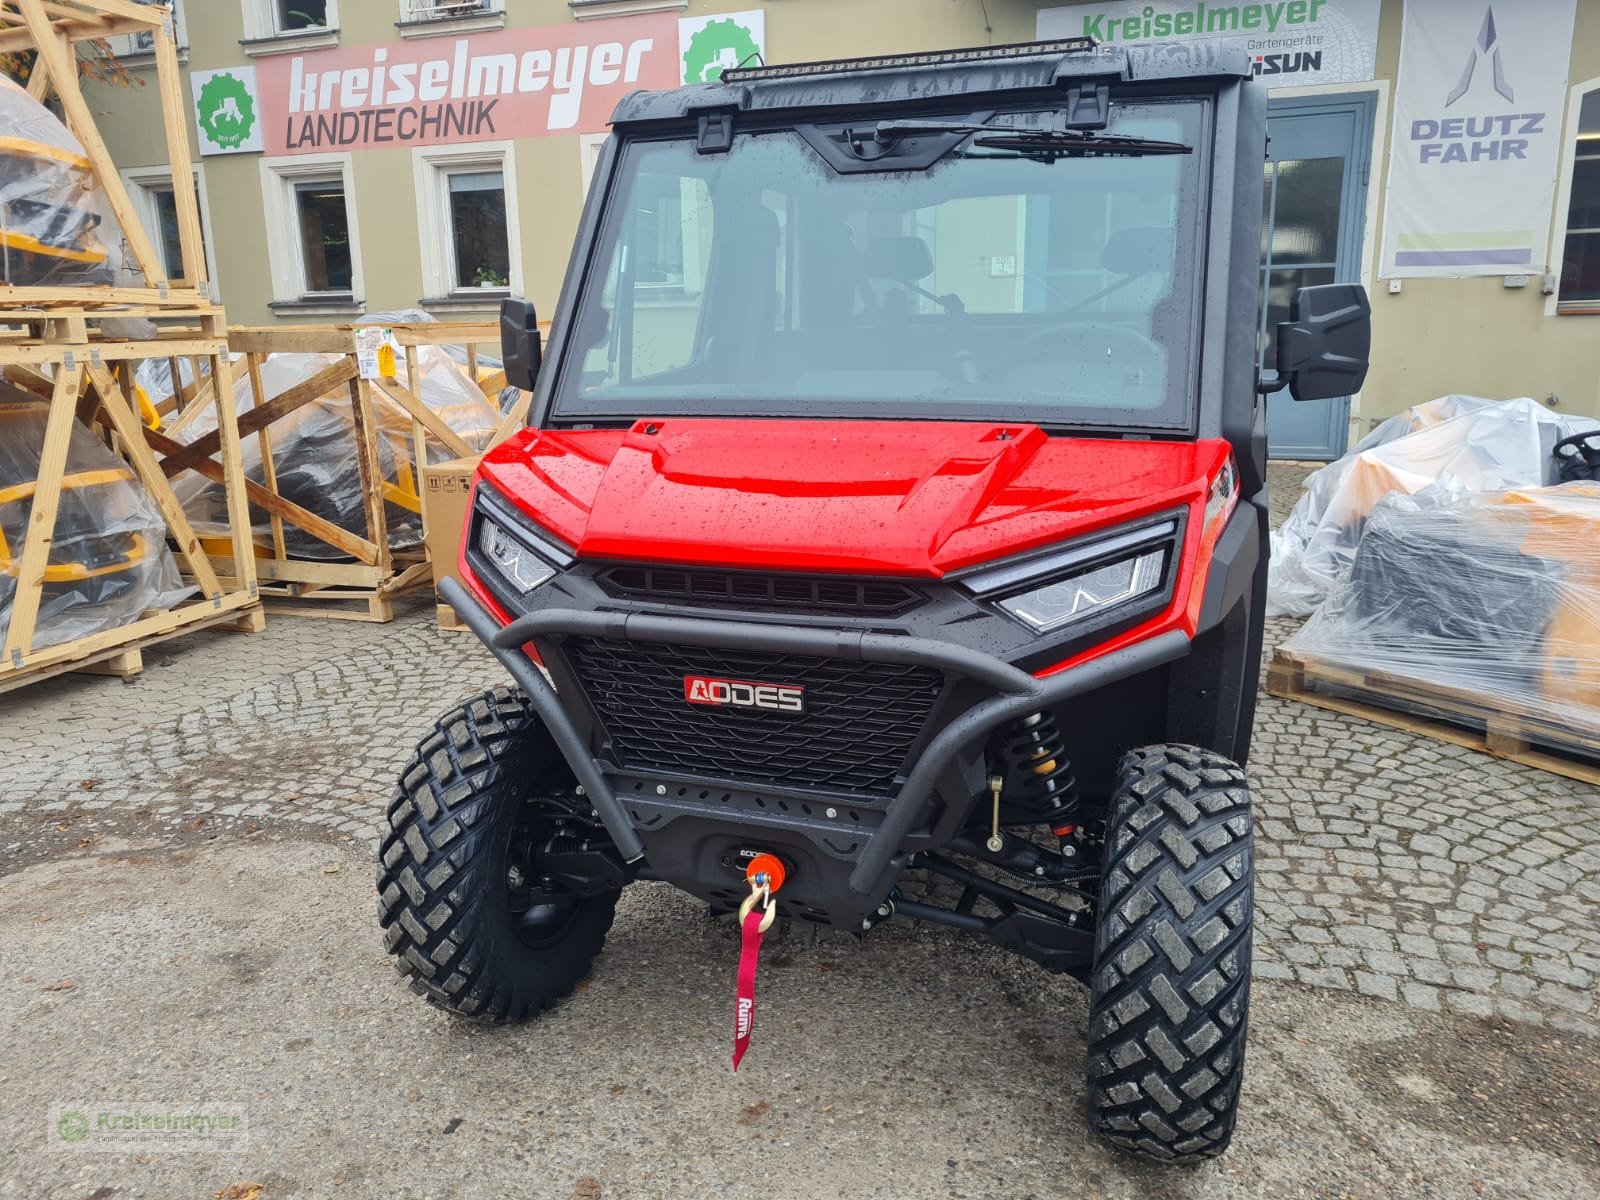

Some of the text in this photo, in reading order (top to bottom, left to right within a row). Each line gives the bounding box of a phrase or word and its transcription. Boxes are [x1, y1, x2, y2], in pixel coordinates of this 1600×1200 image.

[1083, 0, 1327, 42] Kreiselmeyer
[1247, 35, 1324, 50] Gartengeräte
[288, 39, 654, 130] kreiselmeyer
[286, 99, 499, 149] LANDTECHNIK
[1410, 112, 1546, 140] DEUTZ
[1419, 139, 1529, 164] FAHR
[689, 679, 802, 711] AODES
